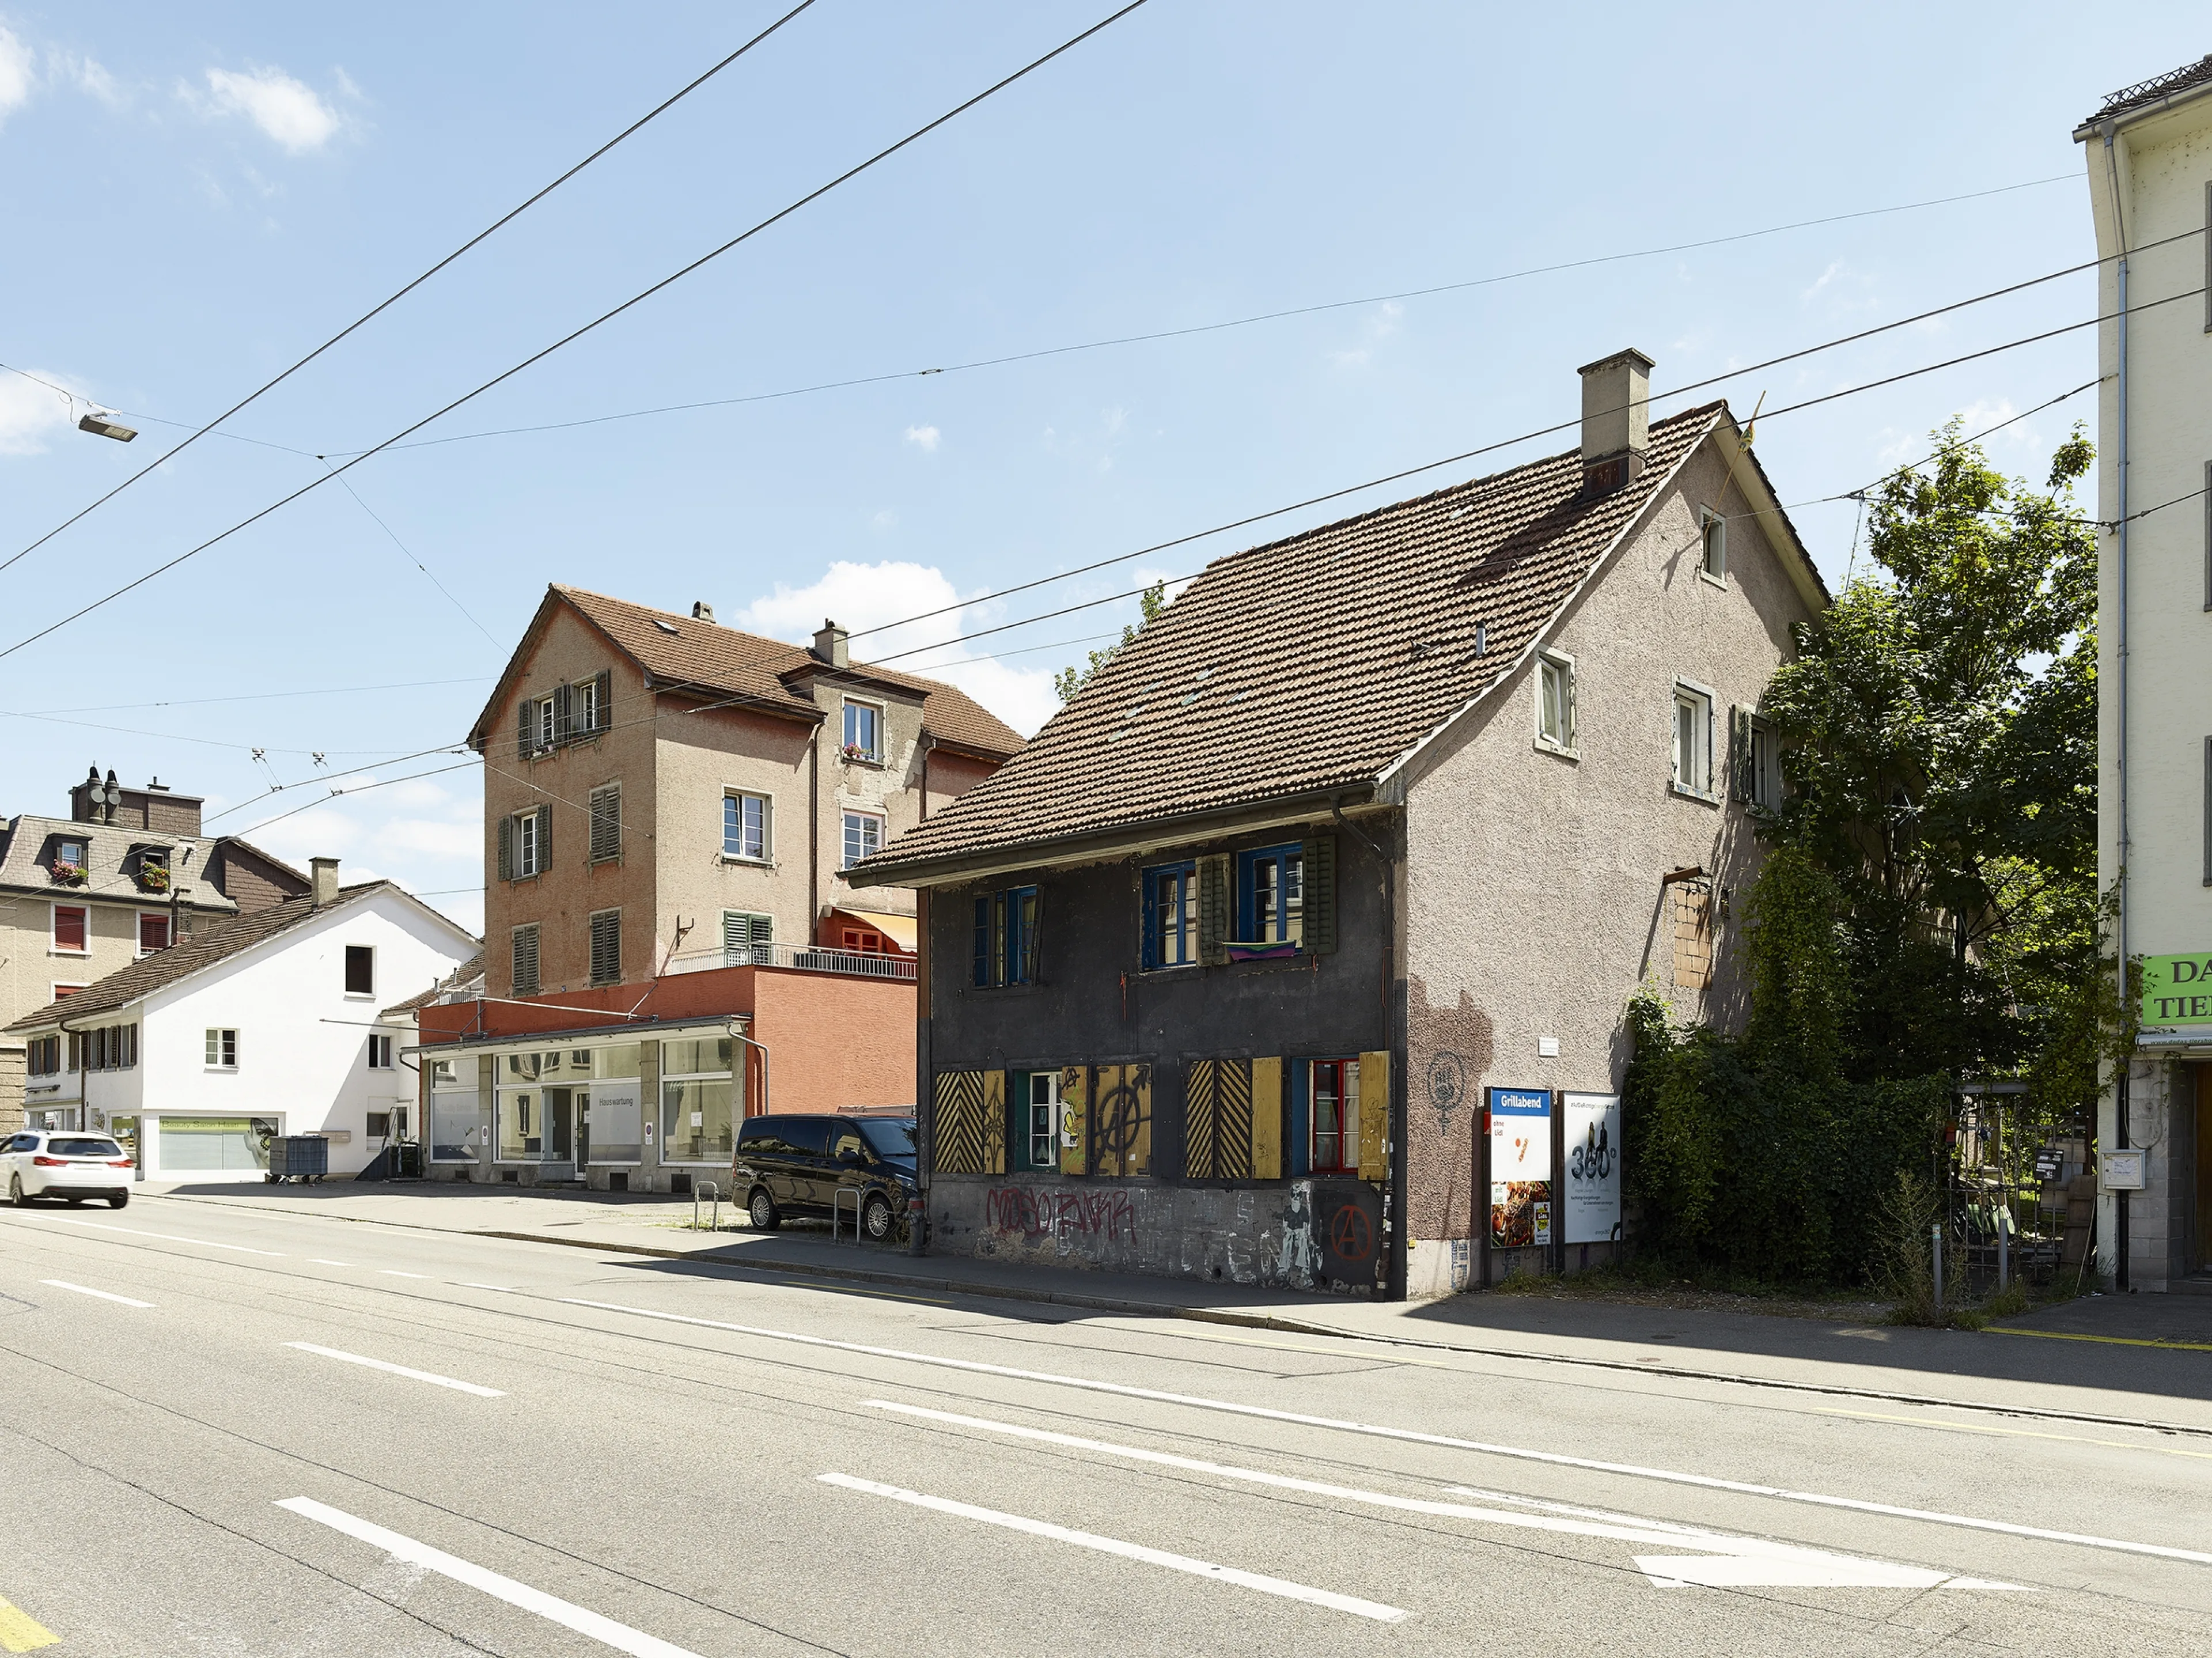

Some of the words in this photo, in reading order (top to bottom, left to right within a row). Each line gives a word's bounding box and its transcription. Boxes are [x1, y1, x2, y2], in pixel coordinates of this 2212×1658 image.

[2153, 995, 2212, 1019] TIE
[599, 1097, 633, 1107] Hauswartung
[1501, 1095, 1541, 1108] Grillabend
[162, 1121, 191, 1129] Beauty
